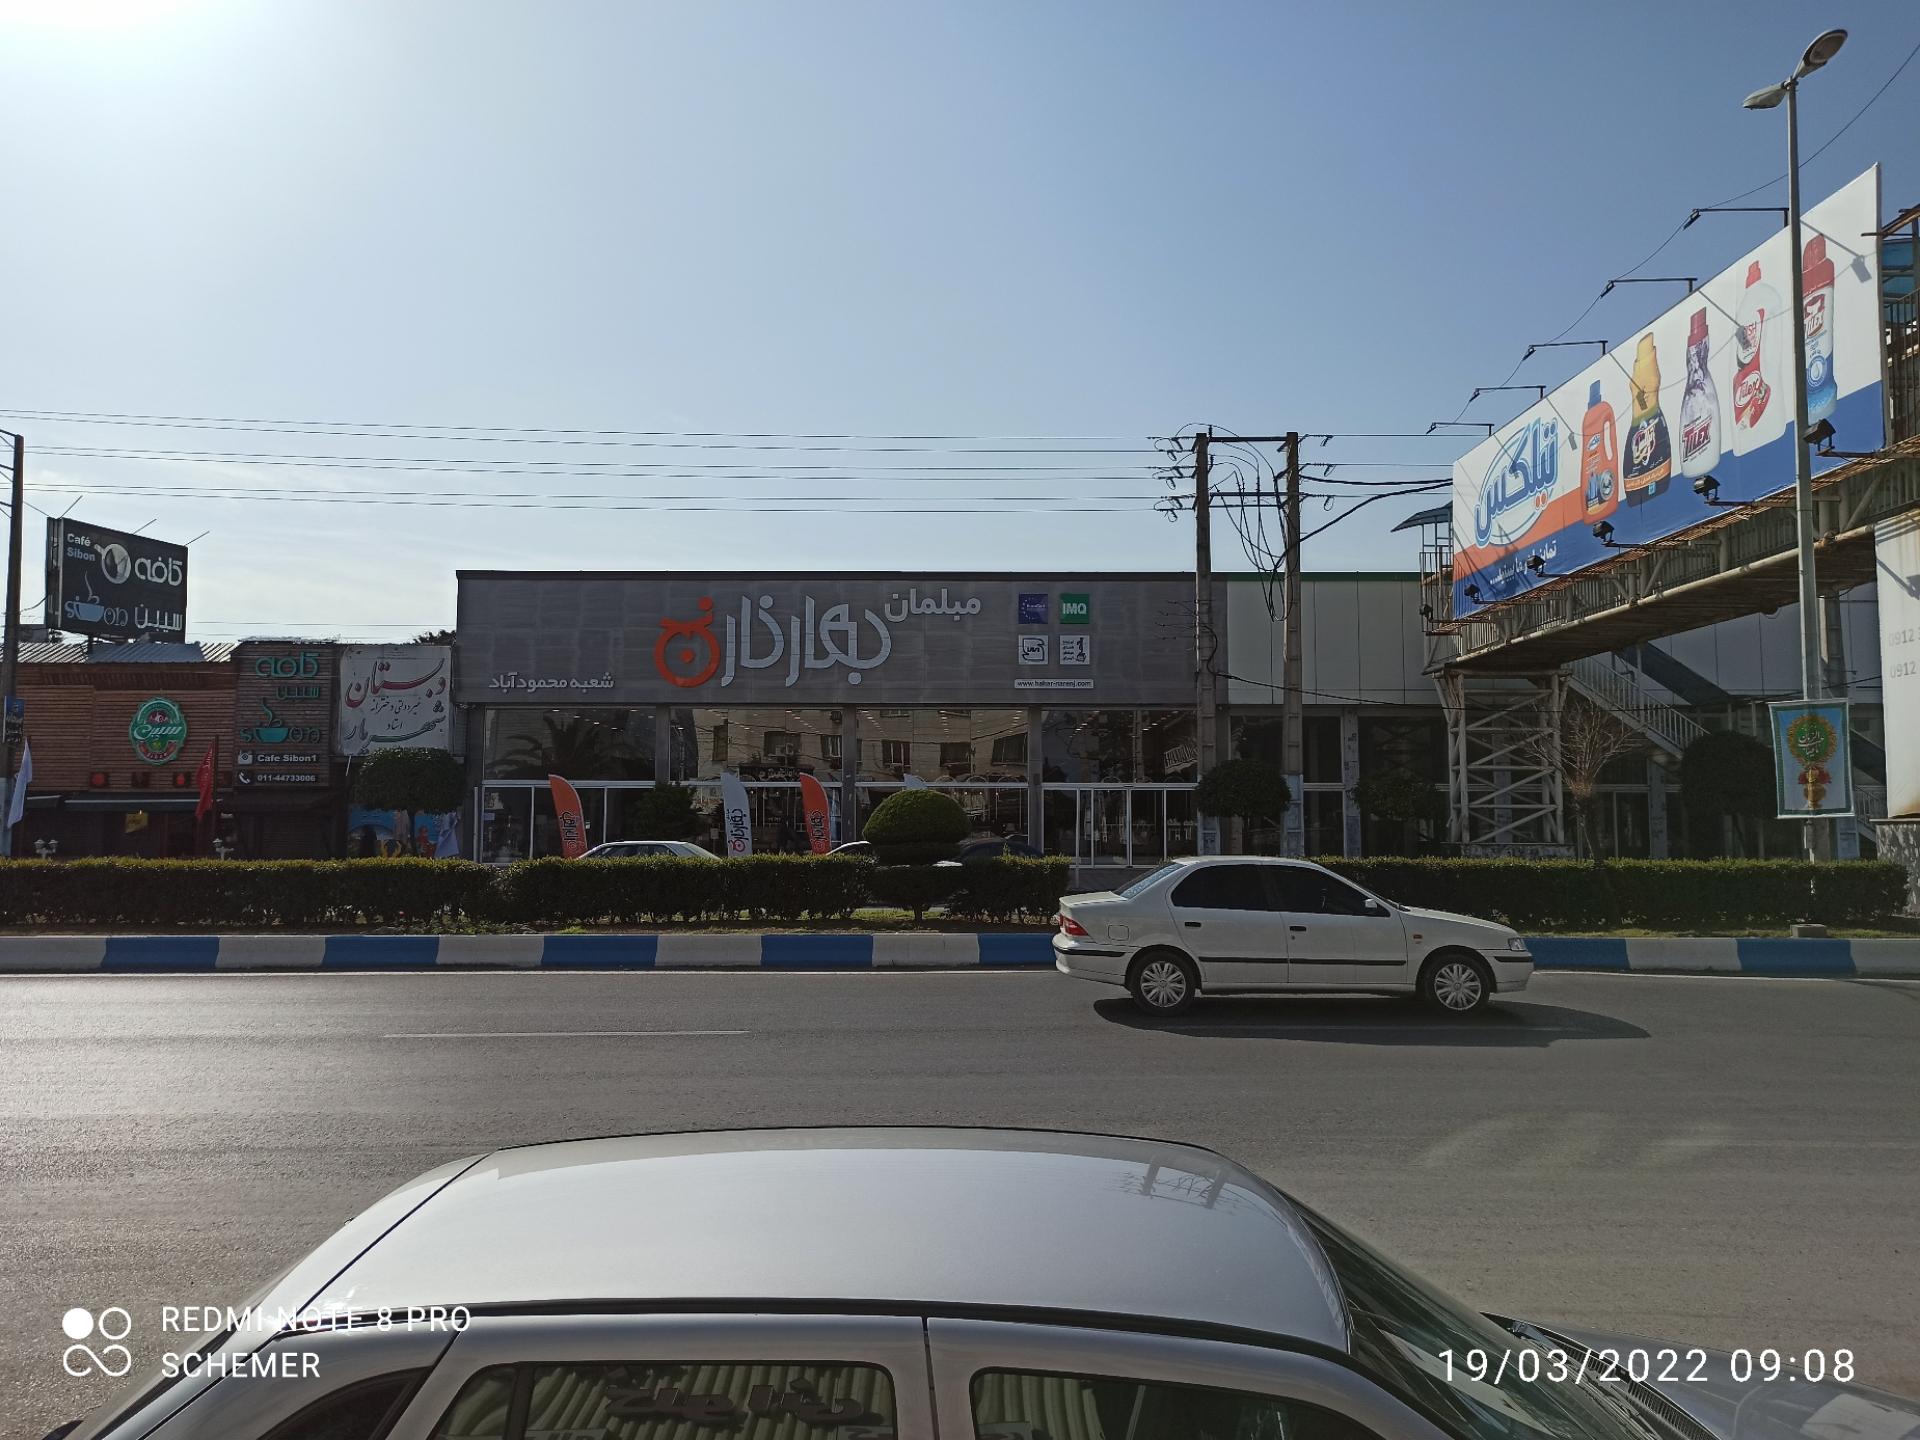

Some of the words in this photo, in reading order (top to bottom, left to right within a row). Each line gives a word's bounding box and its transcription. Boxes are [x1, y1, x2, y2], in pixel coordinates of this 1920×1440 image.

[66, 533, 91, 547] Café
[66, 547, 96, 561] Sibon
[134, 556, 183, 587] کافه
[884, 588, 982, 623] مبلمان
[1062, 602, 1088, 615] IMQ
[255, 651, 320, 678] کافه
[344, 657, 447, 709] دبستان
[569, 672, 614, 693] شعبه
[344, 700, 447, 755] شهریار
[386, 718, 403, 731] استاد
[257, 754, 281, 762] Cafe
[282, 754, 317, 762] Sibon1
